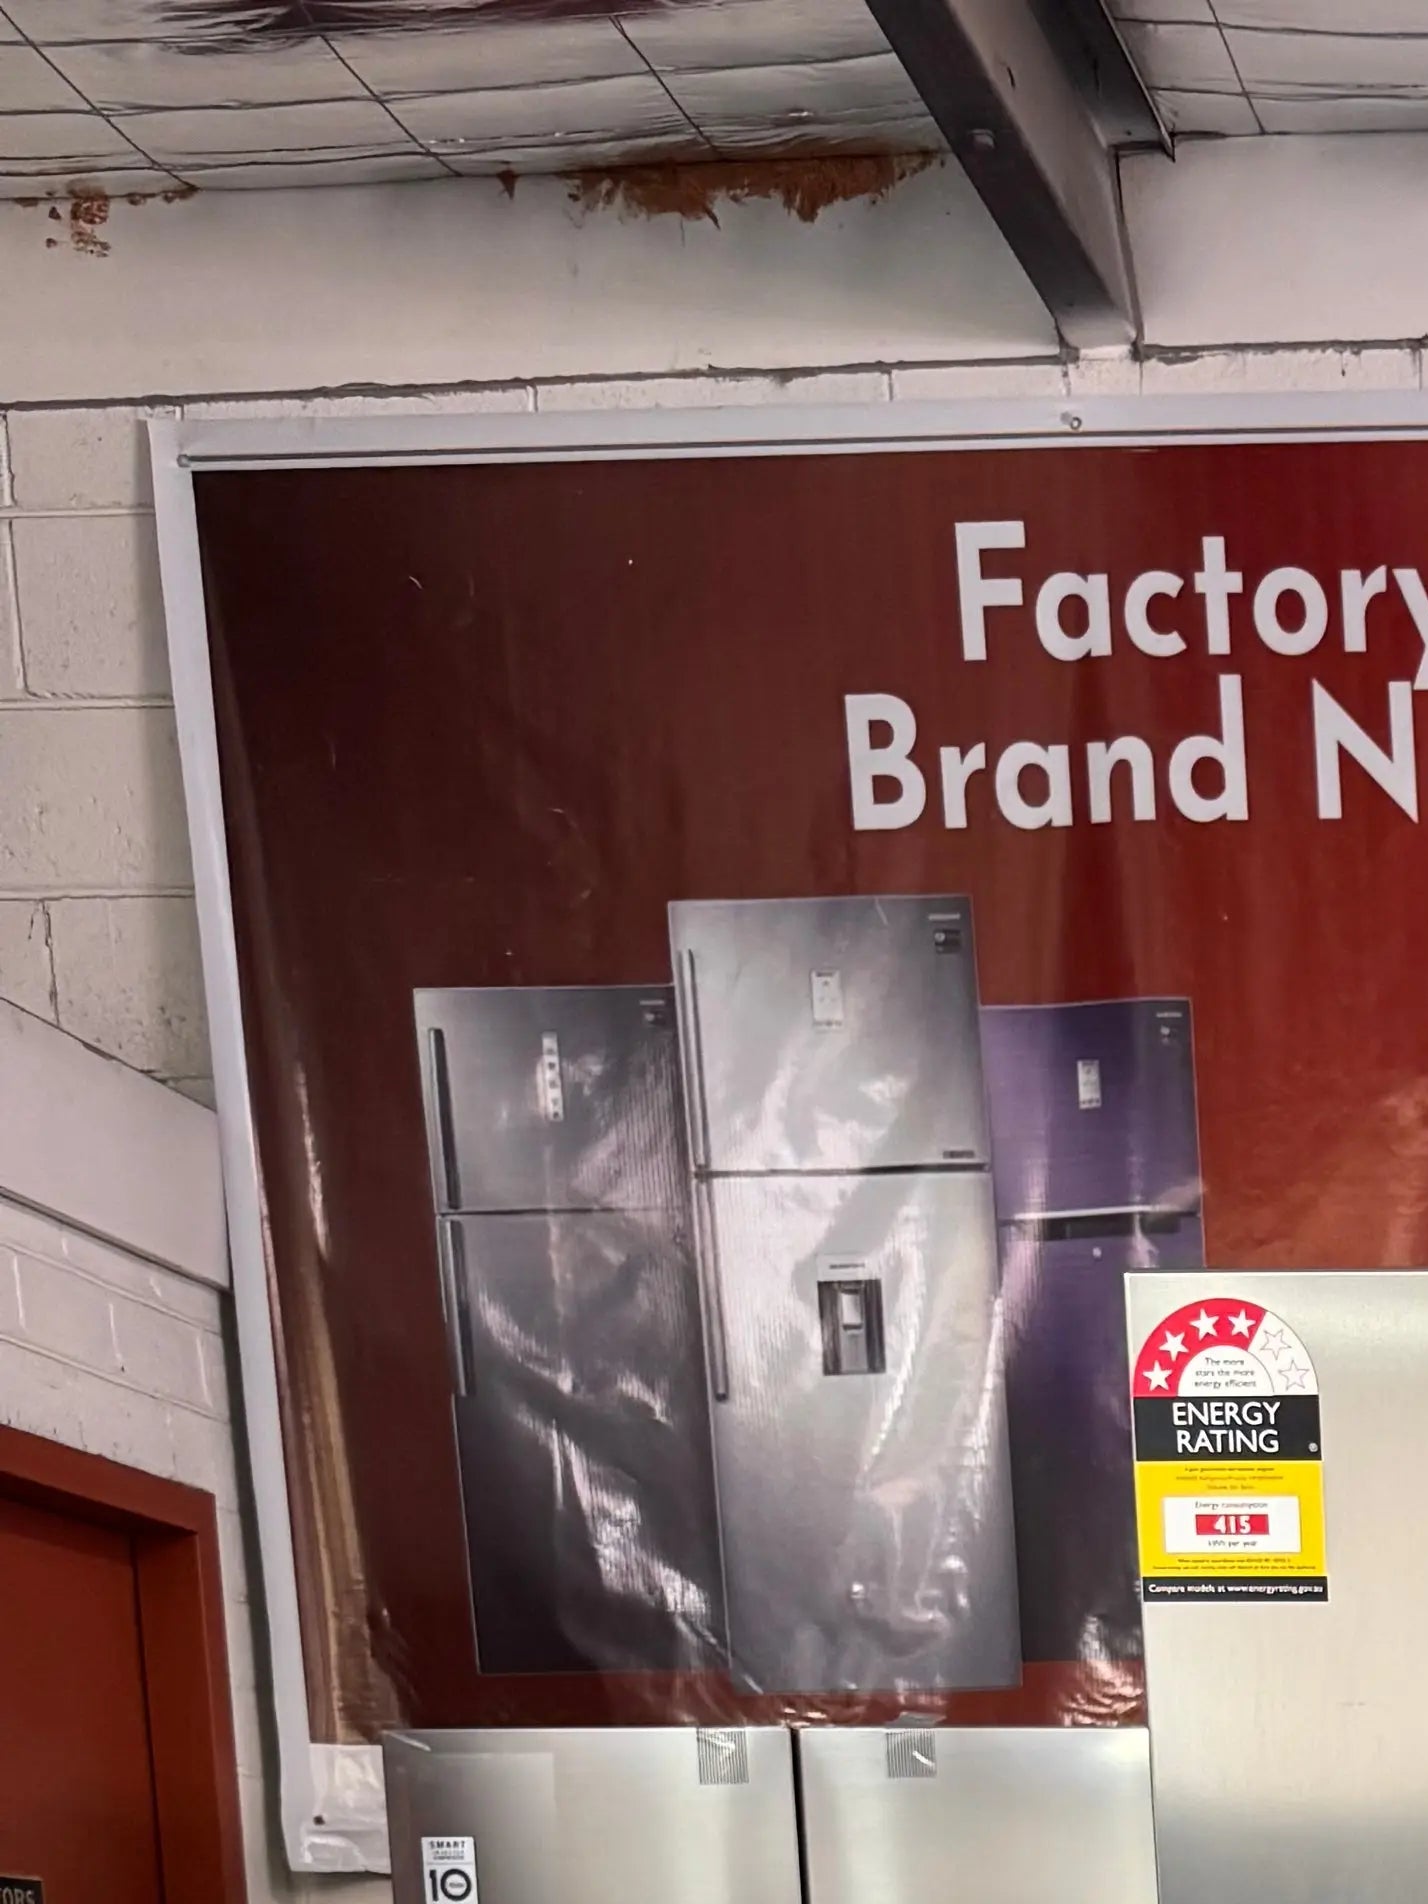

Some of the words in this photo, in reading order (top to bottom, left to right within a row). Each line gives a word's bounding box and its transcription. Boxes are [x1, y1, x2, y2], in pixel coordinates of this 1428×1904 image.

[845, 674, 1248, 832] Brand
[1172, 1402, 1281, 1427] ENERGY
[1177, 1429, 1280, 1453] RATING
[1214, 1515, 1251, 1534] 415
[430, 1868, 472, 1902] 10
